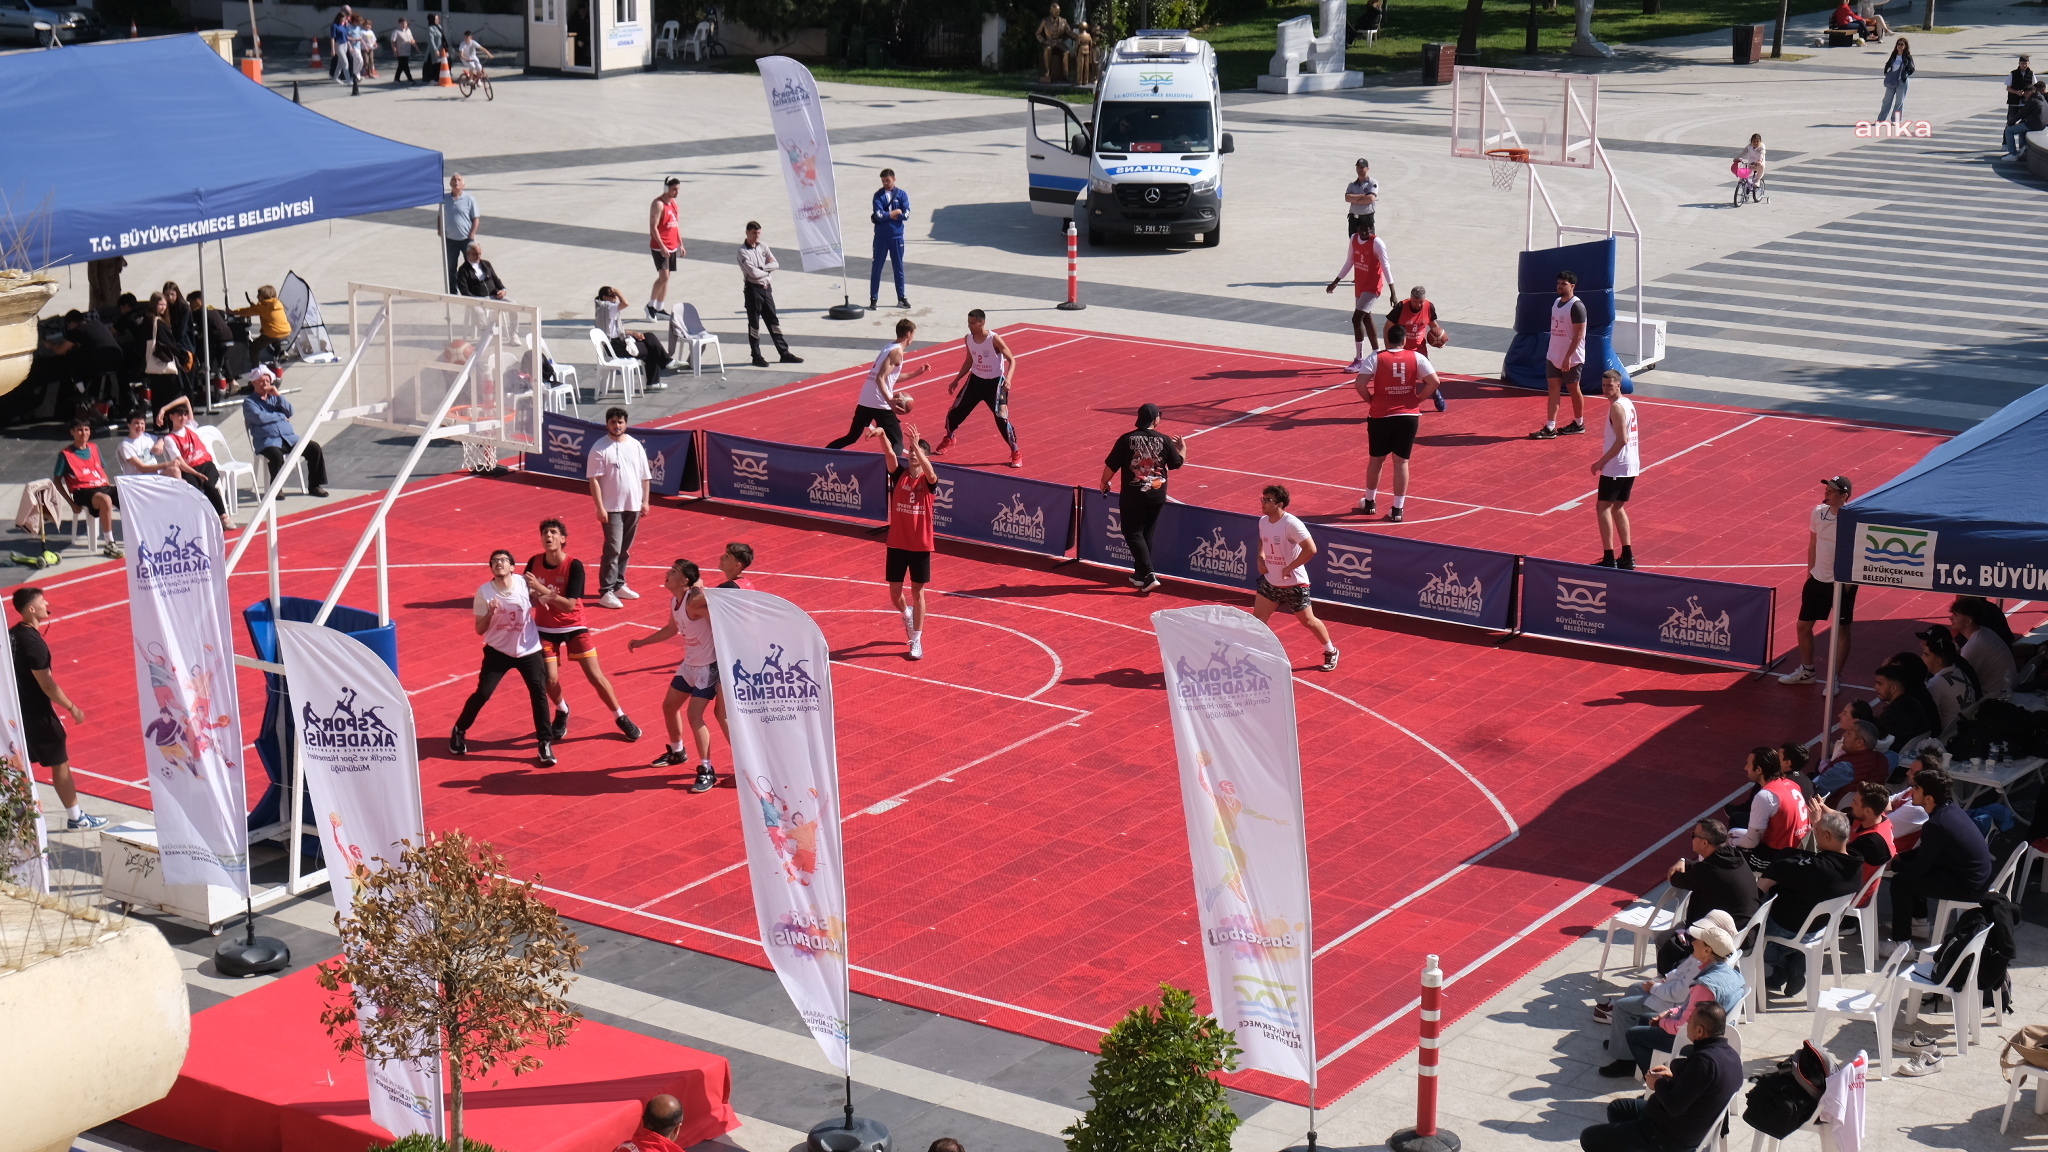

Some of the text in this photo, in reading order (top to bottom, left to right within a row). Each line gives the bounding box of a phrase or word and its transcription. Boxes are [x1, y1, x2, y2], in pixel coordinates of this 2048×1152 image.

[89, 196, 315, 253] T.C. BÜYÜKÇEKMECE BELEDİYESİ
[1392, 362, 1405, 385] 4
[822, 481, 848, 493] SPOR
[909, 492, 915, 503] 2
[1007, 513, 1031, 526] SPOR
[1206, 547, 1234, 560] SPOR
[1863, 564, 1924, 578] BÜYÜKÇEKMECE
[1937, 563, 1973, 586] T.C.
[1343, 577, 1352, 585] T.C.
[1862, 574, 1903, 585] BELEDİYESİ
[1326, 580, 1370, 594] BÜYÜKÇEKMECE
[1332, 588, 1363, 599] BELEDİYESİ
[1437, 582, 1467, 597] SPOR
[509, 611, 516, 621] 3
[1555, 616, 1605, 629] BÜYÜKÇEKMECE
[1563, 624, 1597, 635] BELEDİYESİ
[1680, 617, 1714, 631] SPOR
[1791, 788, 1808, 821] 2
